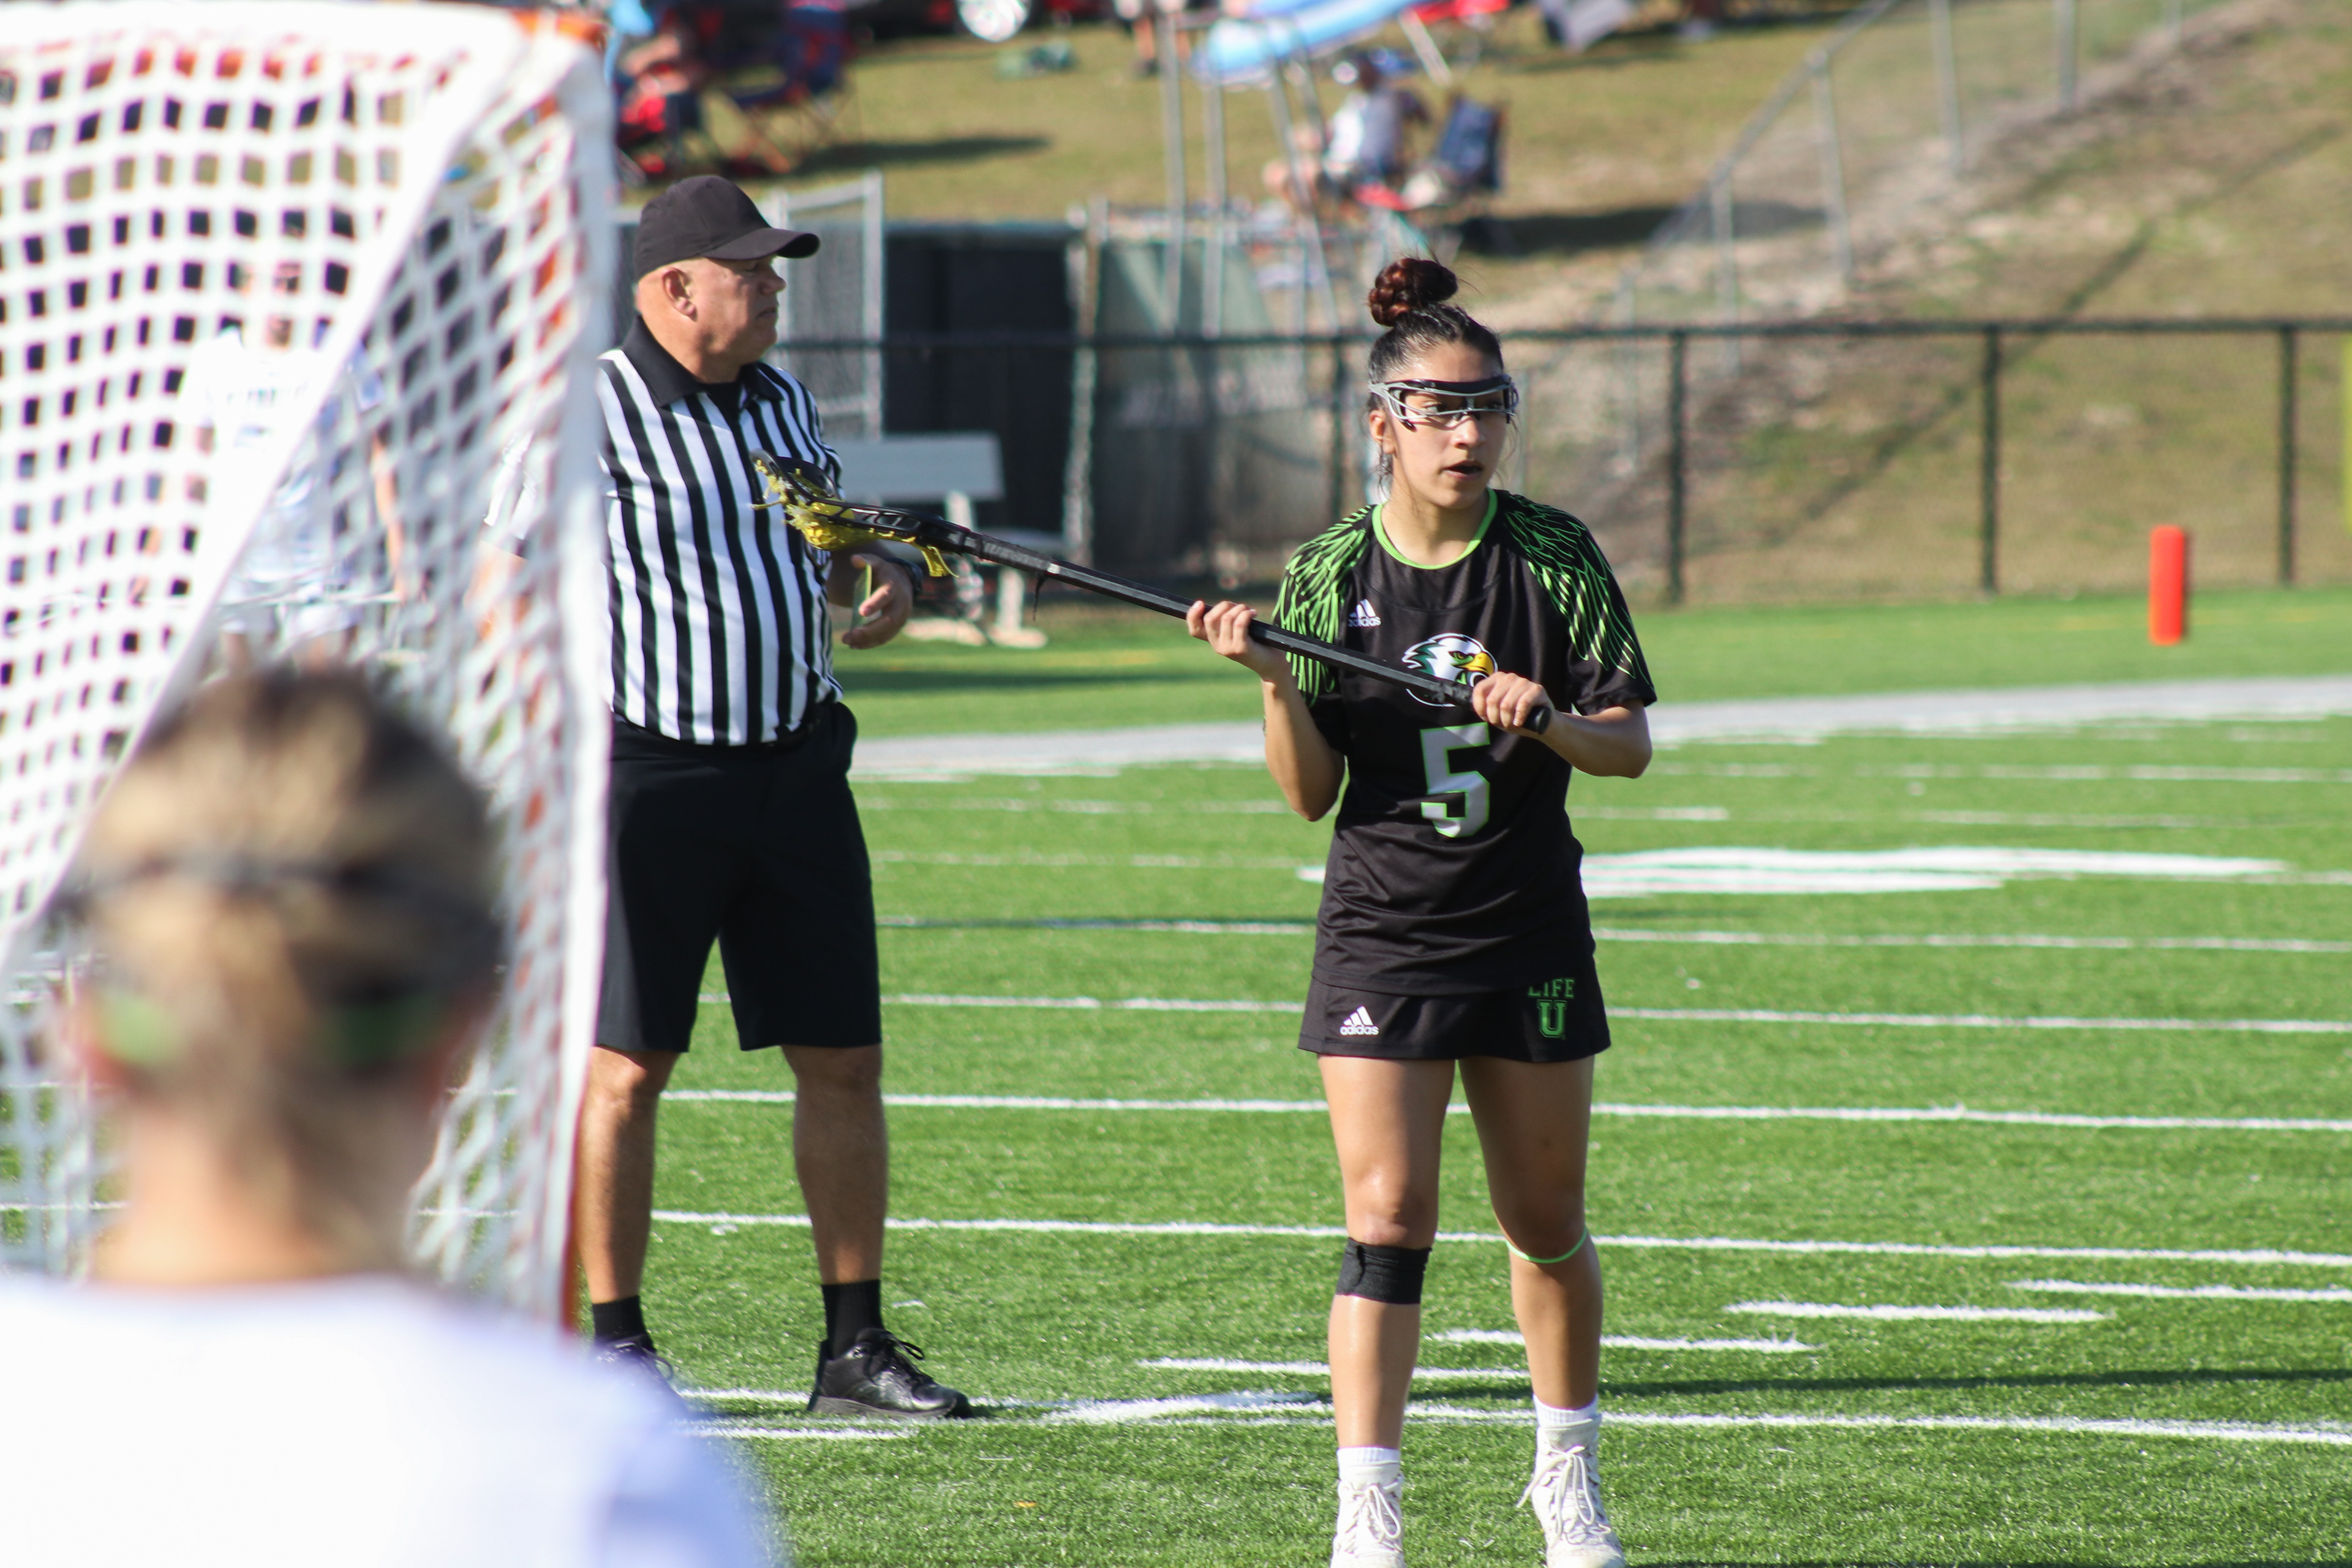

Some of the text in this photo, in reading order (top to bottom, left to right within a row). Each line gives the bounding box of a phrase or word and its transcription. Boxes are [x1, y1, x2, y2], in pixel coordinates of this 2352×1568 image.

[1420, 722, 1490, 838] 5
[1528, 978, 1575, 997] LIFE
[1340, 1023, 1379, 1035] adidas
[1537, 999, 1567, 1038] U
